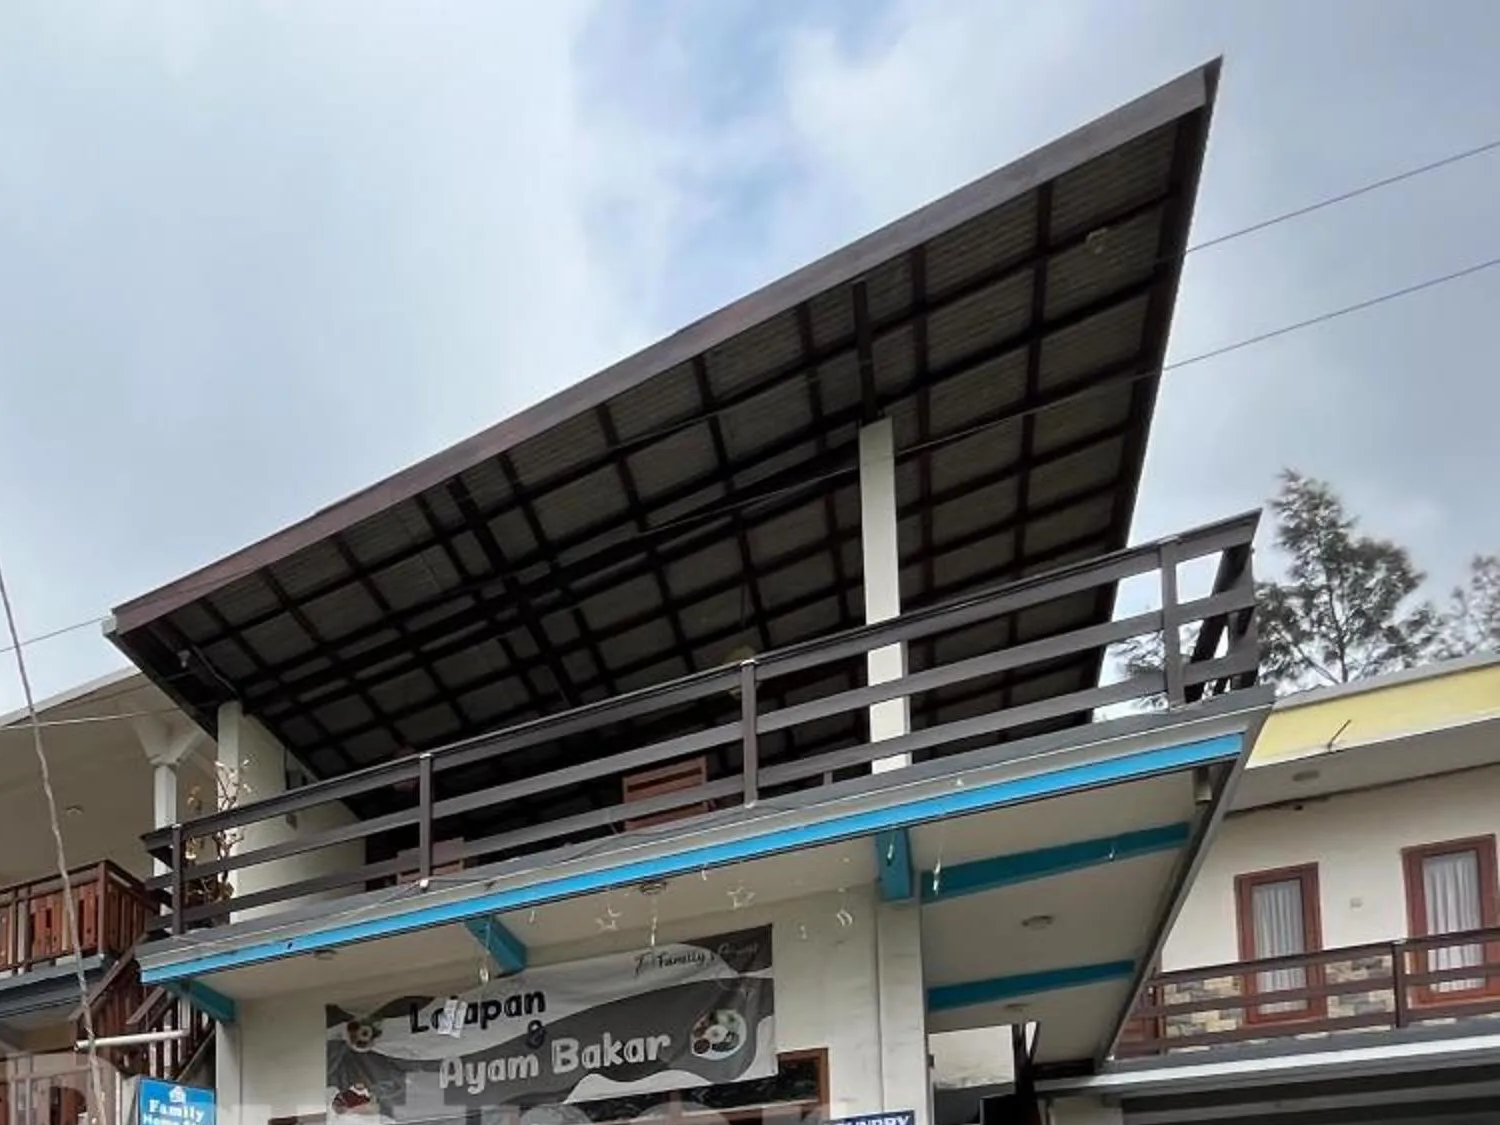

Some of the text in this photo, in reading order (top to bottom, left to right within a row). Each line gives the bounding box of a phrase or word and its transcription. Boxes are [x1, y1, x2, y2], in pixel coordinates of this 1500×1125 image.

[409, 991, 546, 1033] Laapan
[439, 1032, 671, 1094] Ayam Bakar
[148, 1099, 205, 1123] Family
